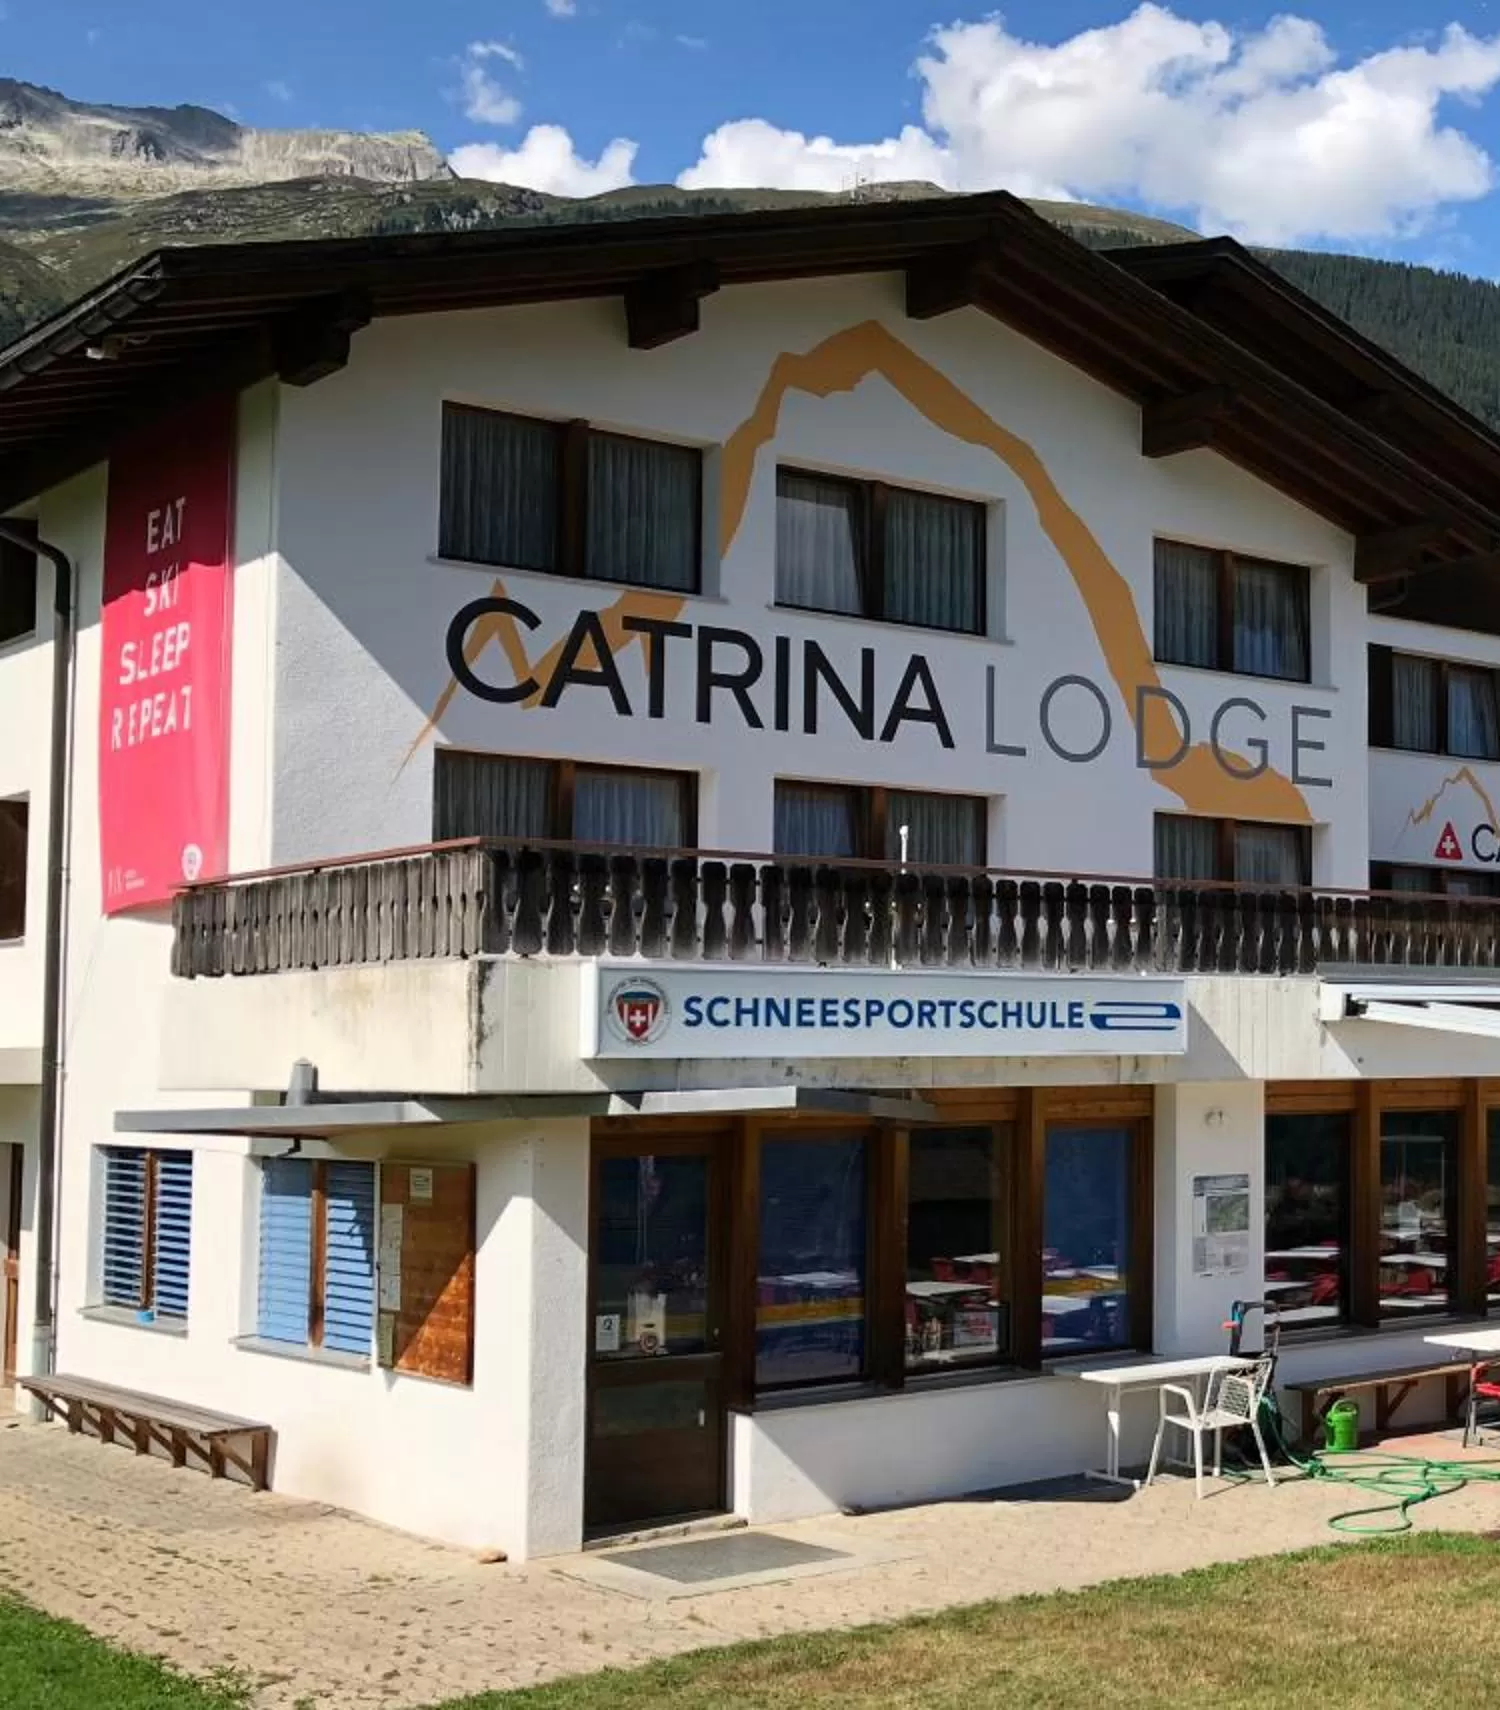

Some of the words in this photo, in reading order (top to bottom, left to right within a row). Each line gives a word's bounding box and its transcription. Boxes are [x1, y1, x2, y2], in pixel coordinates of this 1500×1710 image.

[147, 496, 186, 554] EAT
[144, 562, 179, 617] SKI
[119, 622, 190, 685] SLEEP
[111, 685, 192, 752] REPEAT
[446, 596, 955, 749] CATRINA
[985, 664, 1333, 788] LODGE
[683, 995, 1084, 1029] SCHNEESPORTSCHULE
